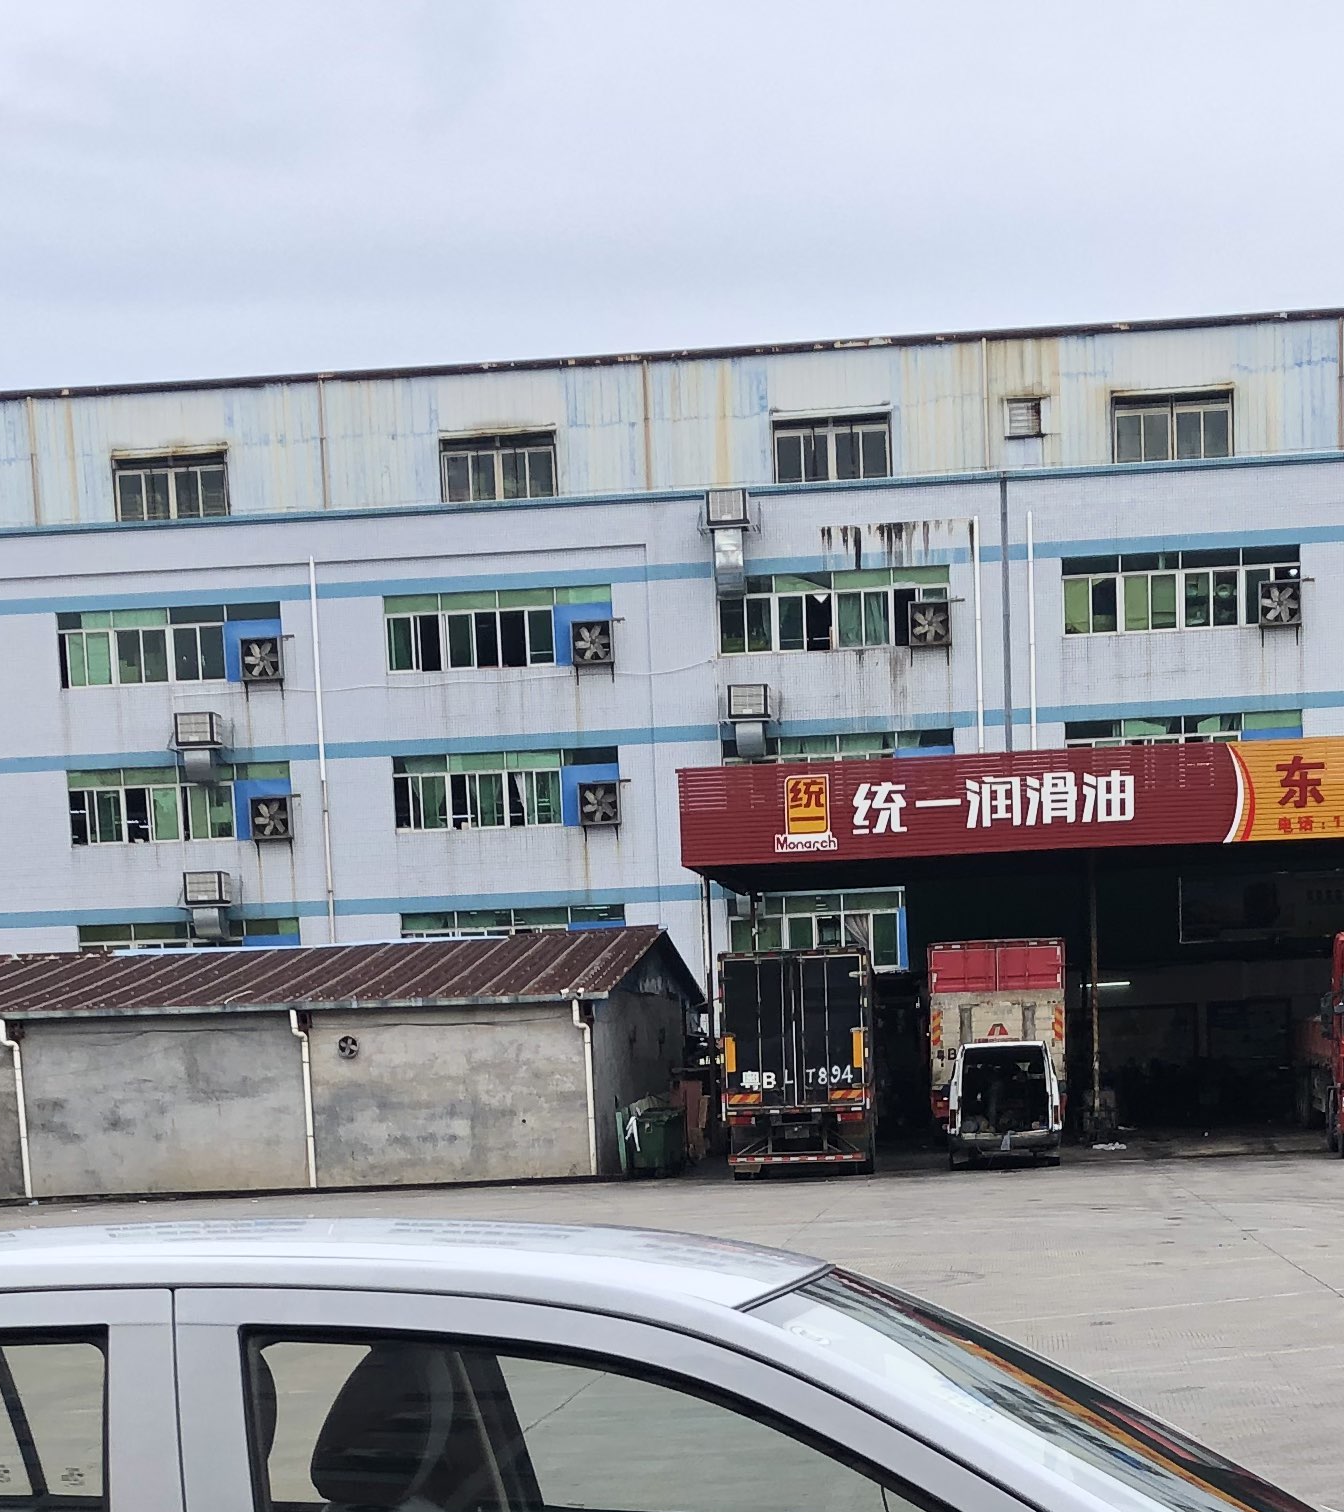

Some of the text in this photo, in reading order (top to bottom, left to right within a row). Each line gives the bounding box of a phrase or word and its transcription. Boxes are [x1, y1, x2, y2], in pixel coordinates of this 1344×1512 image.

[852, 770, 1136, 834] 统一润滑油
[776, 834, 837, 851] Monarch
